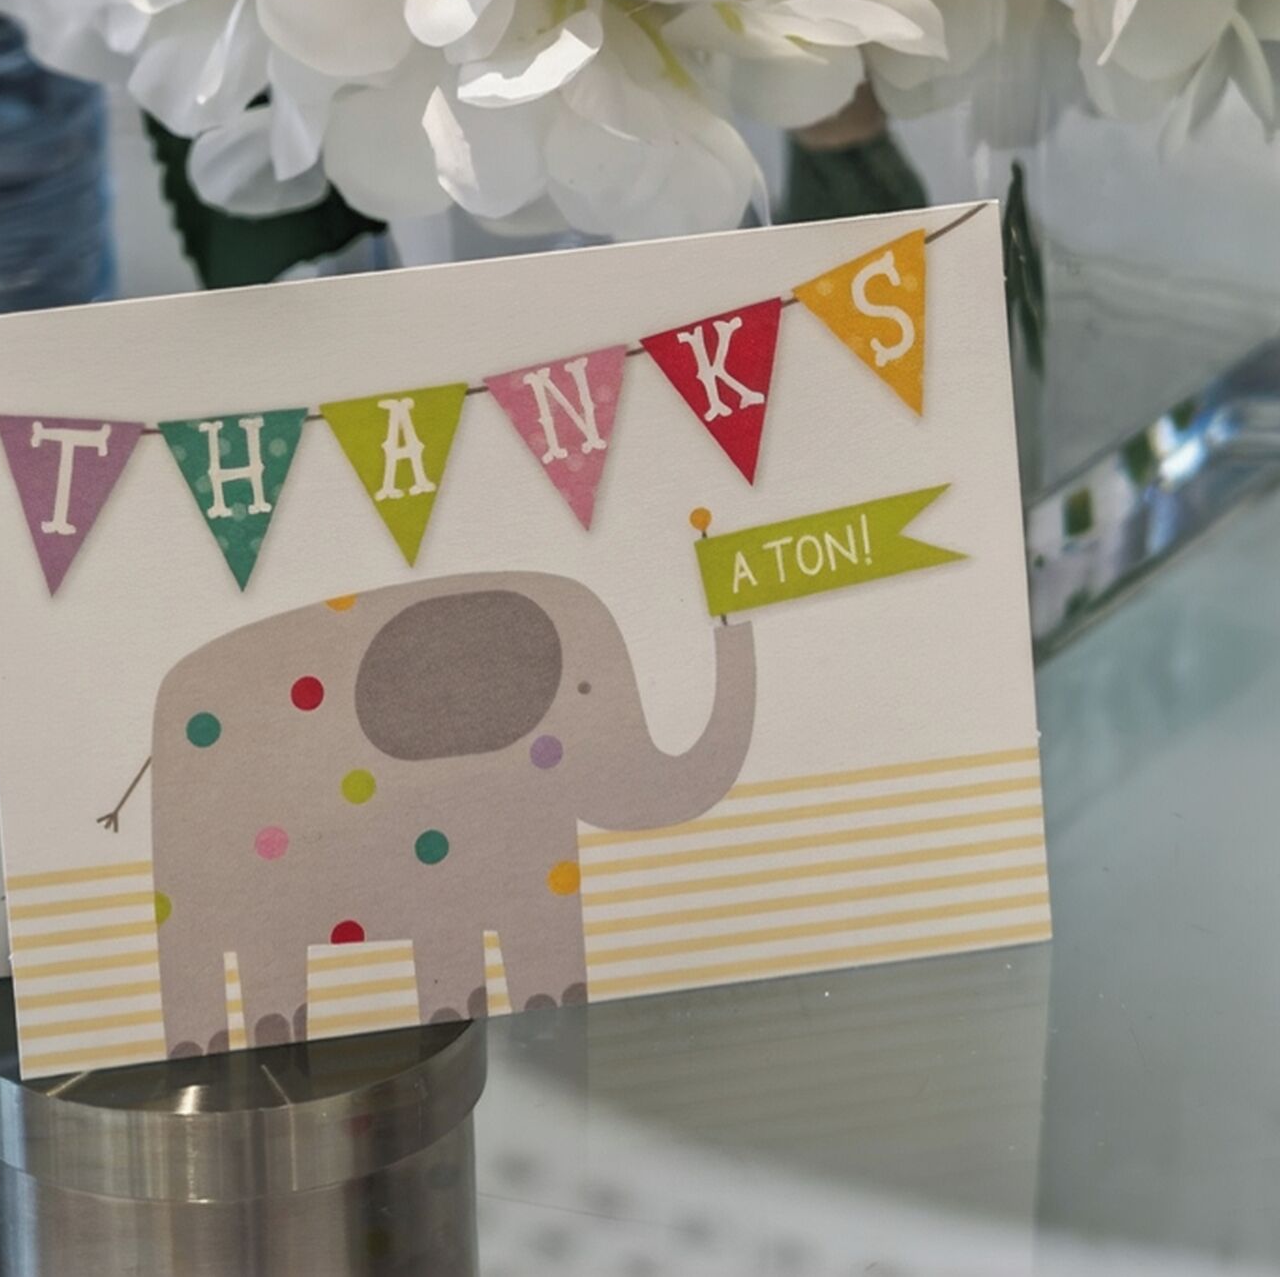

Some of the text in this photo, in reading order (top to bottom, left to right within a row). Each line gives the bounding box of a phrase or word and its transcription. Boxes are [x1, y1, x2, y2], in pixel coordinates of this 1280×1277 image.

[31, 248, 918, 536] THANKS
[730, 512, 876, 593] A TON!
